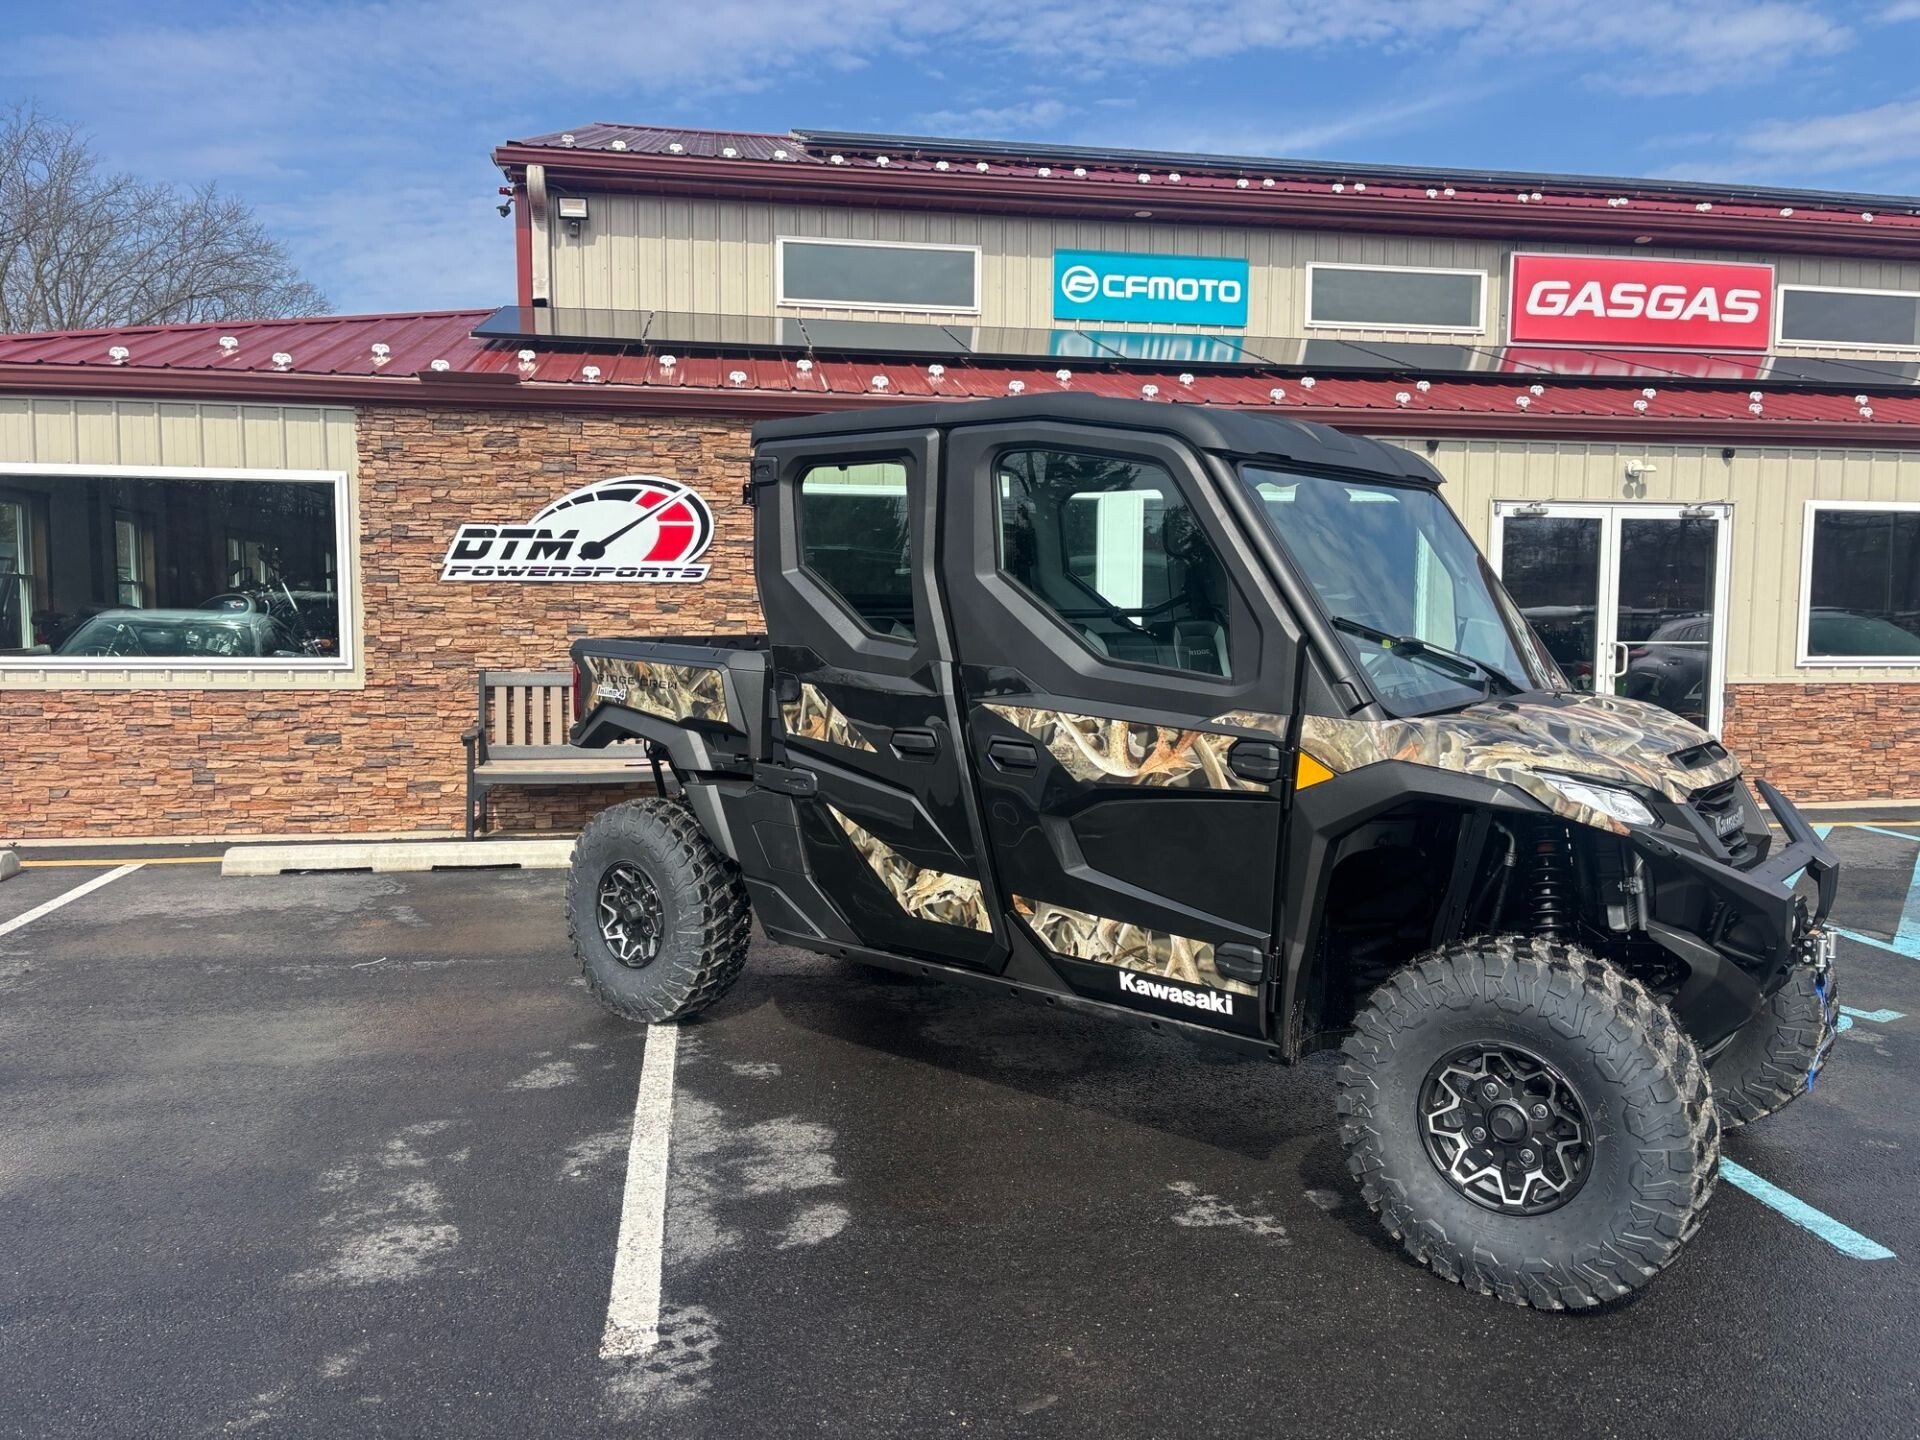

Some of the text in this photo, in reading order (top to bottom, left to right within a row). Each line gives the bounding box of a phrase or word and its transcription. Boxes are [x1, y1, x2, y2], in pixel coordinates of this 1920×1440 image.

[1102, 274, 1241, 303] CFMOTO
[1526, 280, 1761, 323] GASGAS
[451, 528, 579, 560] DTM
[448, 565, 705, 578] POWERSPORTS
[597, 674, 635, 685] RIDGE
[1118, 971, 1233, 1015] Kawasaki
